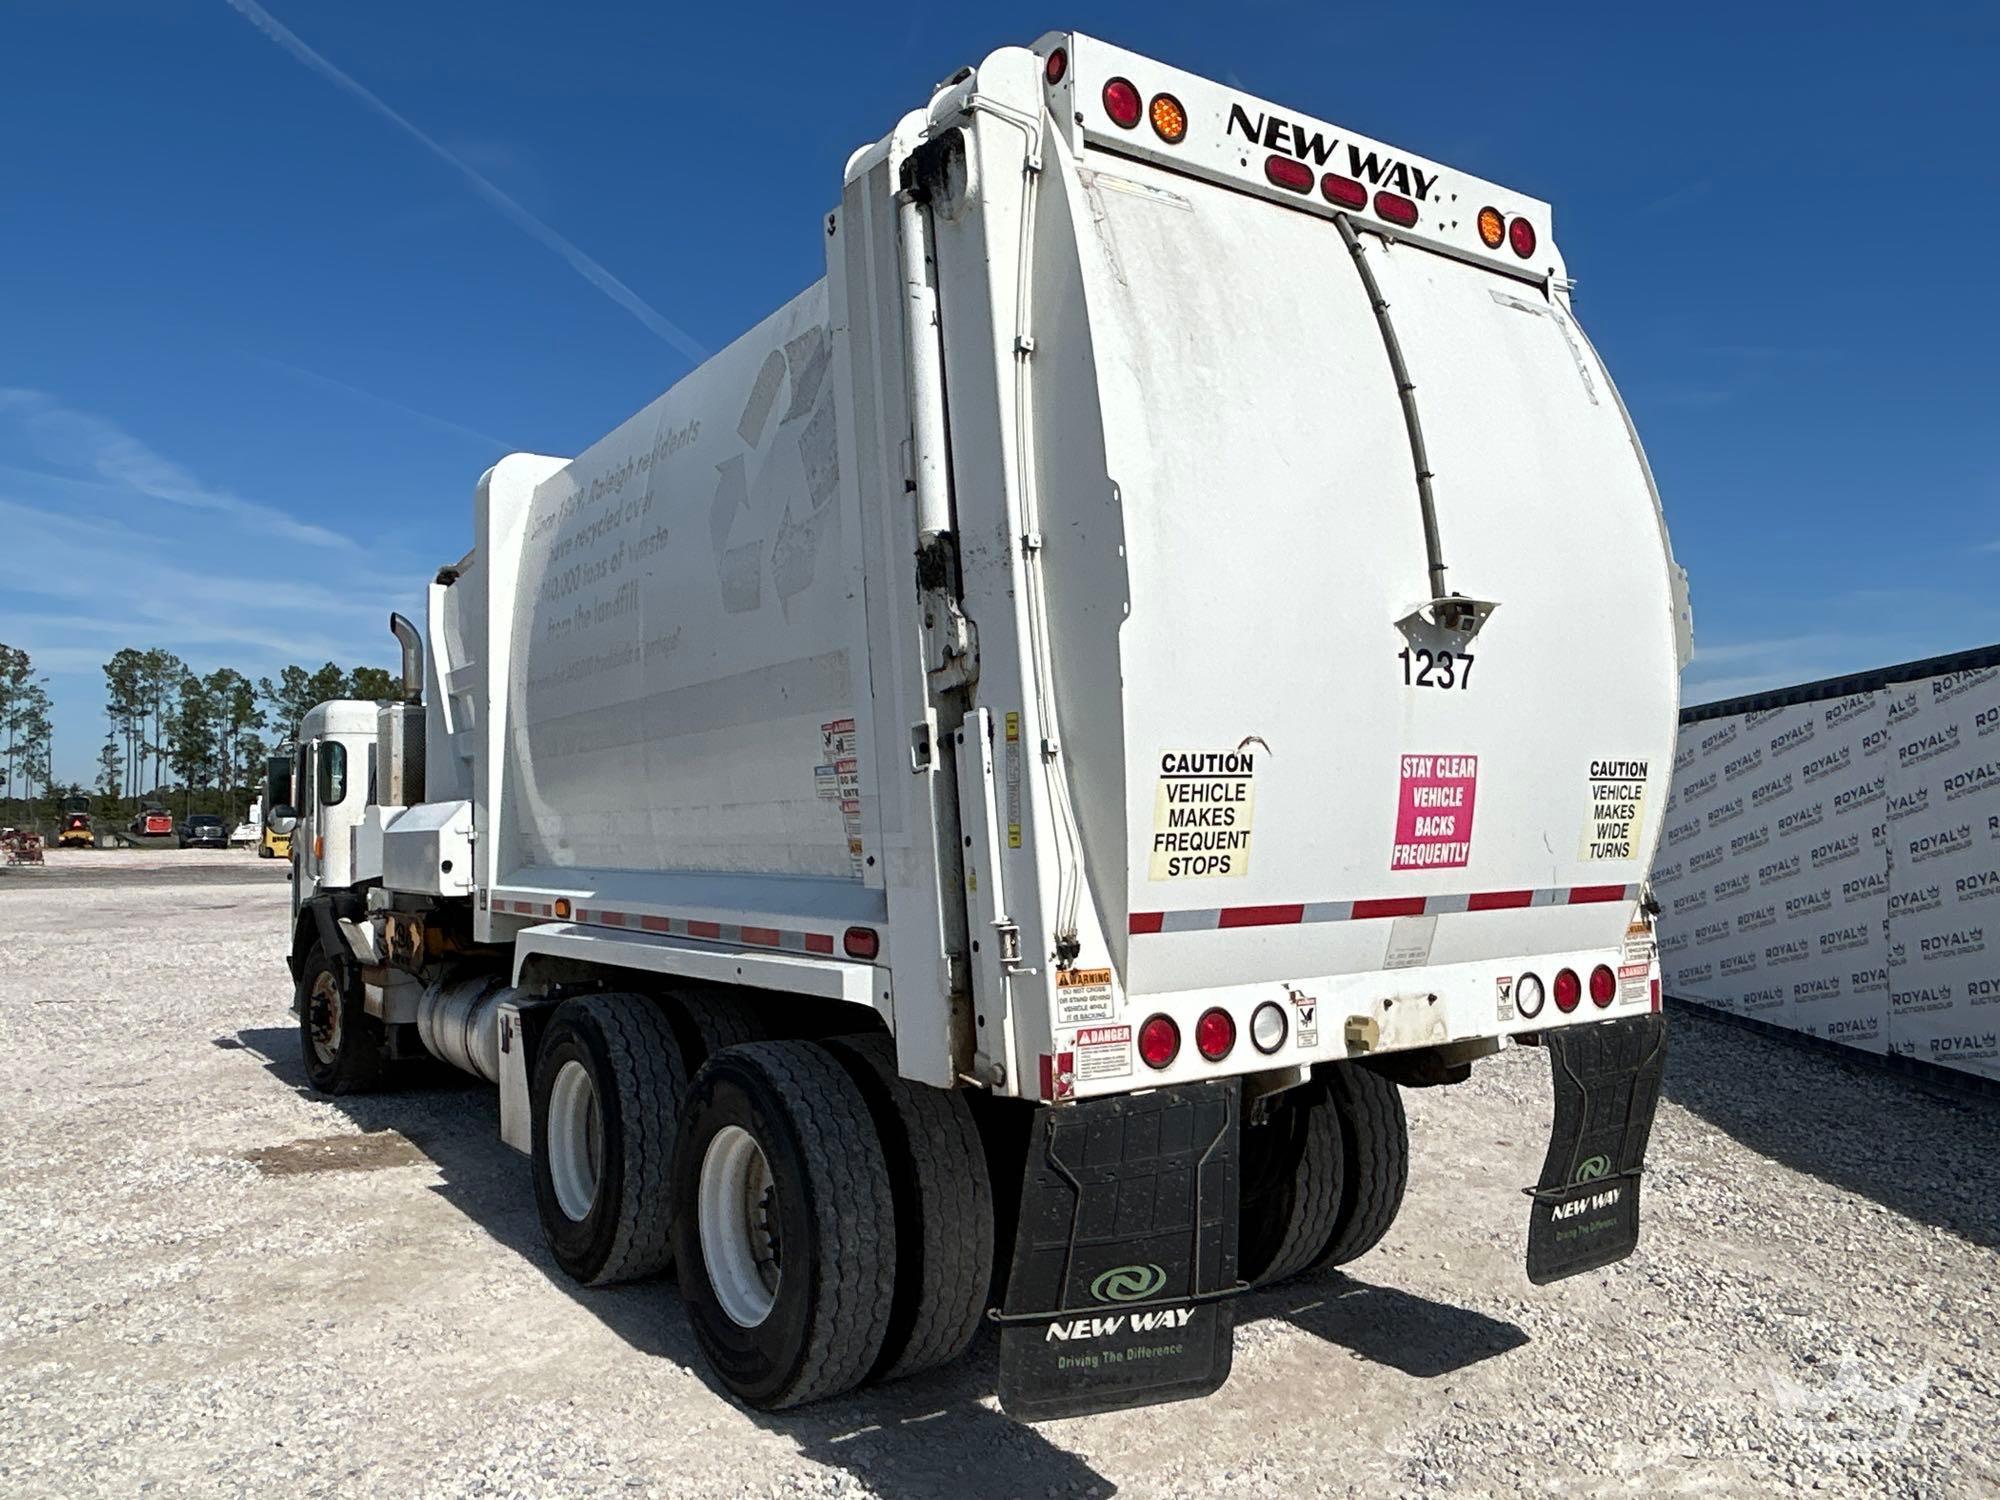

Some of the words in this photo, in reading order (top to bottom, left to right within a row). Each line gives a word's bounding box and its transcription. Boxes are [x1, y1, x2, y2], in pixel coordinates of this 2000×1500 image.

[1226, 103, 1338, 166] NEW
[1347, 144, 1439, 201] WAY
[1398, 647, 1475, 690] 1237
[1825, 695, 1863, 721] ROYAL
[1771, 726, 1804, 750] ROYAL
[1899, 732, 1946, 759] ROYAL
[1161, 753, 1254, 773] CAUTION
[1402, 758, 1433, 778] STAY
[1436, 757, 1476, 779] CLEAR
[1590, 761, 1648, 778] CAUTION
[1802, 752, 1840, 776] ROYAL
[1944, 764, 1995, 792] ROYAL
[1166, 783, 1246, 802] VEHICLE
[1413, 787, 1464, 808] VEHICLE
[1592, 785, 1642, 800] VEHICLE
[1752, 778, 1783, 800] ROYAL
[1834, 783, 1873, 807] ROYAL
[1169, 808, 1235, 827] MAKES
[1593, 805, 1635, 820] MAKES
[1778, 808, 1812, 830] ROYAL
[1415, 816, 1455, 837] BACKS
[1597, 824, 1629, 839] WIDE
[1154, 831, 1250, 852] FREQUENT
[1590, 843, 1630, 858] TURNS
[1811, 839, 1848, 860] ROYAL
[1910, 829, 1958, 854] ROYAL
[1393, 843, 1469, 865] FREQUENTLY
[1168, 856, 1231, 876] STOPS
[1843, 873, 1884, 895] ROYAL
[1785, 893, 1822, 912] ROYAL
[1888, 890, 1927, 909] OYAL
[1820, 928, 1857, 946] ROYAL
[1921, 932, 1969, 951] ROYAL
[1765, 942, 1799, 959] ROYAL
[1070, 973, 1110, 985] WARNING
[1852, 968, 1888, 985] ROYA
[1794, 979, 1830, 996] ROYAL
[1892, 989, 1939, 1006] ROYAL
[1091, 1028, 1130, 1043] DANGER
[1828, 1018, 1865, 1035] ROYAL
[1930, 1035, 1982, 1052] ROYAL
[1551, 1197, 1591, 1222] NEW
[1592, 1187, 1622, 1210] WAY
[1045, 1315, 1125, 1342] NEW
[1130, 1306, 1197, 1333] WAY
[1058, 1354, 1099, 1369] Driving
[1103, 1351, 1123, 1363] The
[1127, 1343, 1184, 1361] Difference
